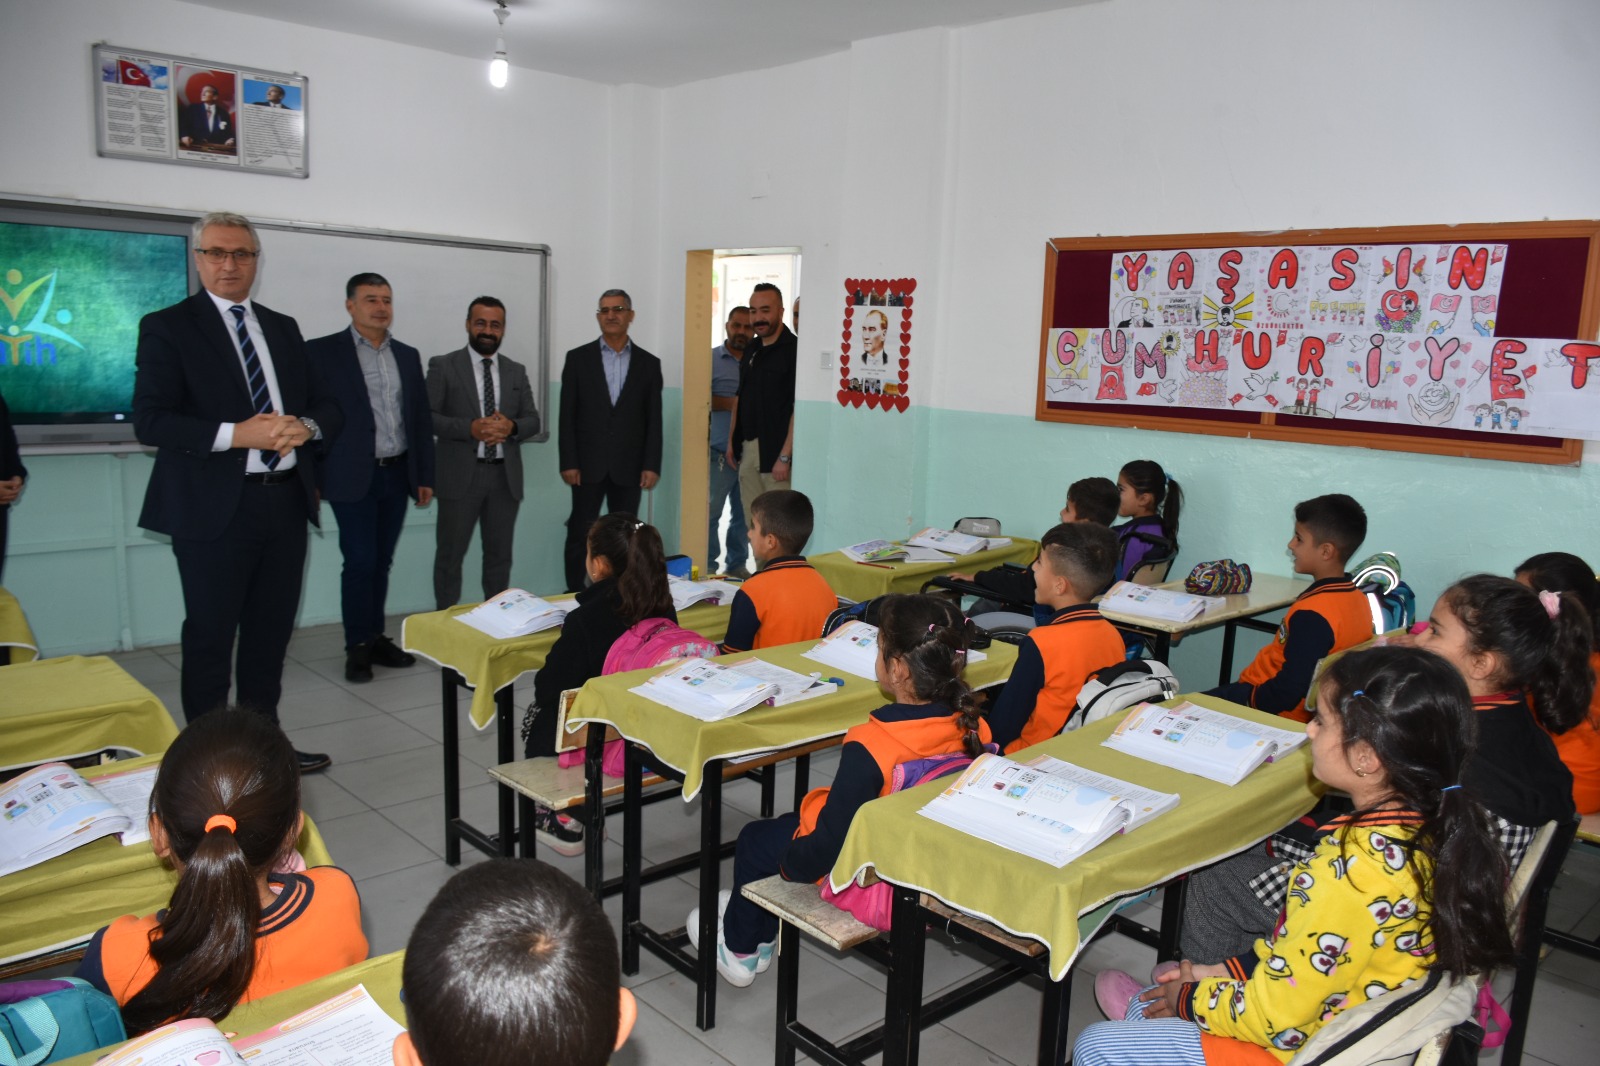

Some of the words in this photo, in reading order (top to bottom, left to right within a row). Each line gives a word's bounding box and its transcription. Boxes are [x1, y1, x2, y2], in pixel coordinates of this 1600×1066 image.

[1122, 246, 1489, 304] YAŞASIN
[1057, 329, 1600, 401] CUMHURİYET
[1340, 392, 1371, 411] 29
[1371, 397, 1398, 410] EKİM
